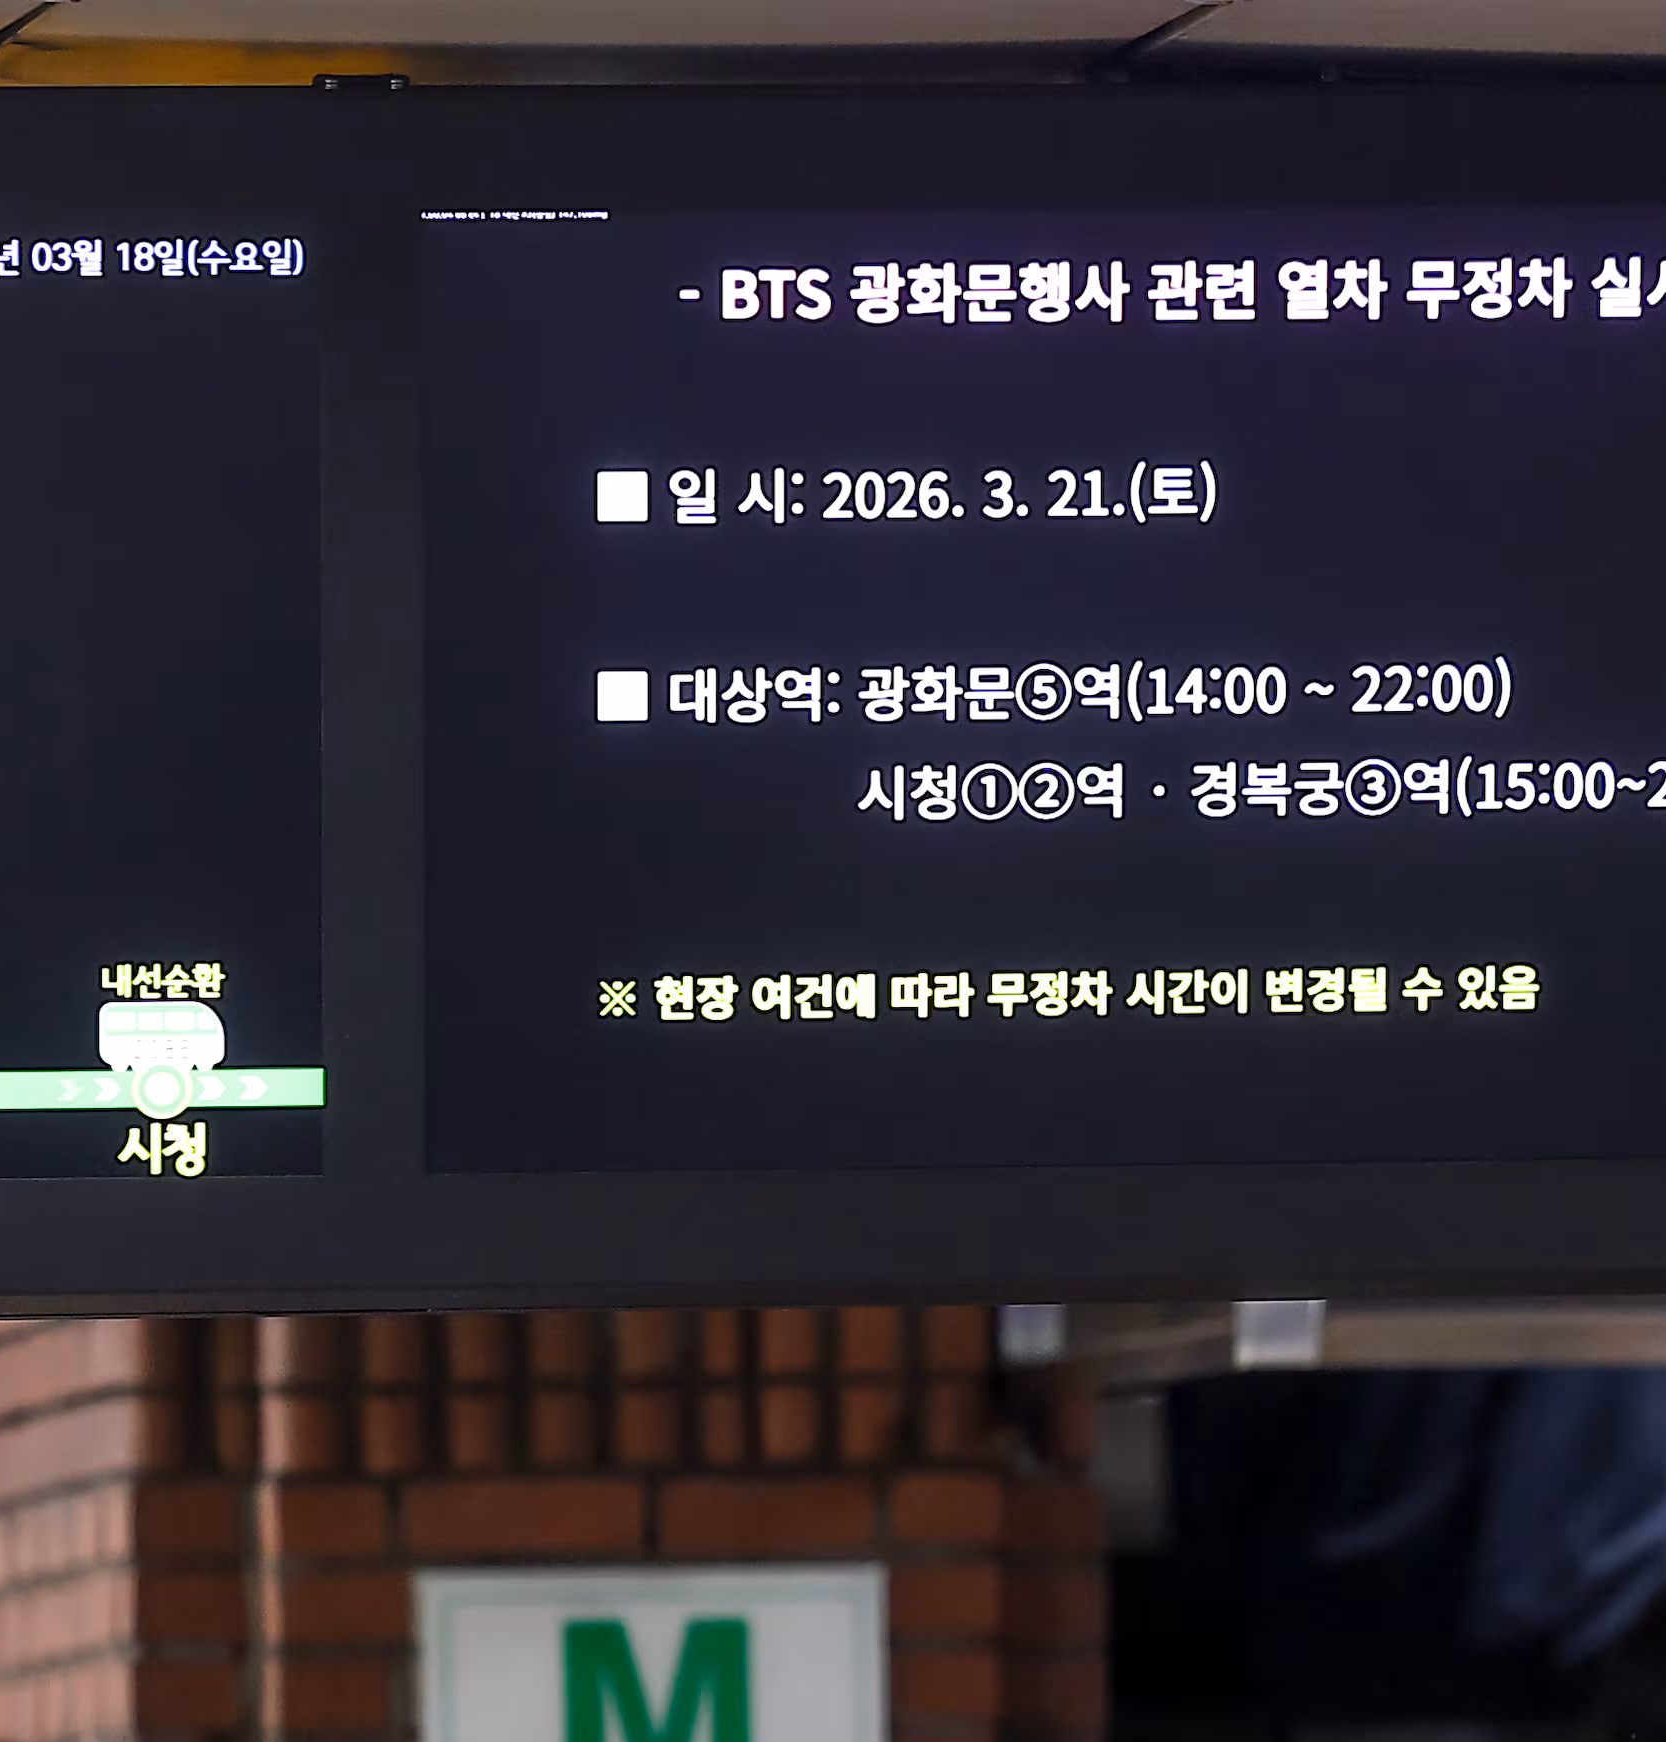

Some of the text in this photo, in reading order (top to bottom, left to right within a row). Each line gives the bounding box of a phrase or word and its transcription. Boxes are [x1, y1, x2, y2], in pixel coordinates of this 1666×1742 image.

[31, 238, 103, 277] 03월
[116, 238, 304, 277] 18일(수요일)
[722, 268, 832, 320] BTS
[849, 260, 1131, 324] 광화문행사
[1147, 259, 1256, 321] 관련
[1278, 258, 1389, 321] 열차
[1406, 256, 1573, 320] 무정차
[669, 460, 1216, 524] 일 시: 2026. 3. 21.(토)
[669, 666, 840, 724] 대상역:
[1351, 656, 1511, 718] 22:00)
[101, 962, 226, 999] 내선순환
[653, 974, 739, 1021] 현장
[751, 973, 876, 1020] 여건에
[890, 971, 976, 1018] 따라
[986, 970, 1114, 1017] 무정차
[1126, 968, 1248, 1015] 시간이
[1265, 966, 1387, 1013] 변경될
[1401, 966, 1444, 1012] 수
[1457, 965, 1540, 1011] 있음
[117, 1121, 206, 1177] 시청
